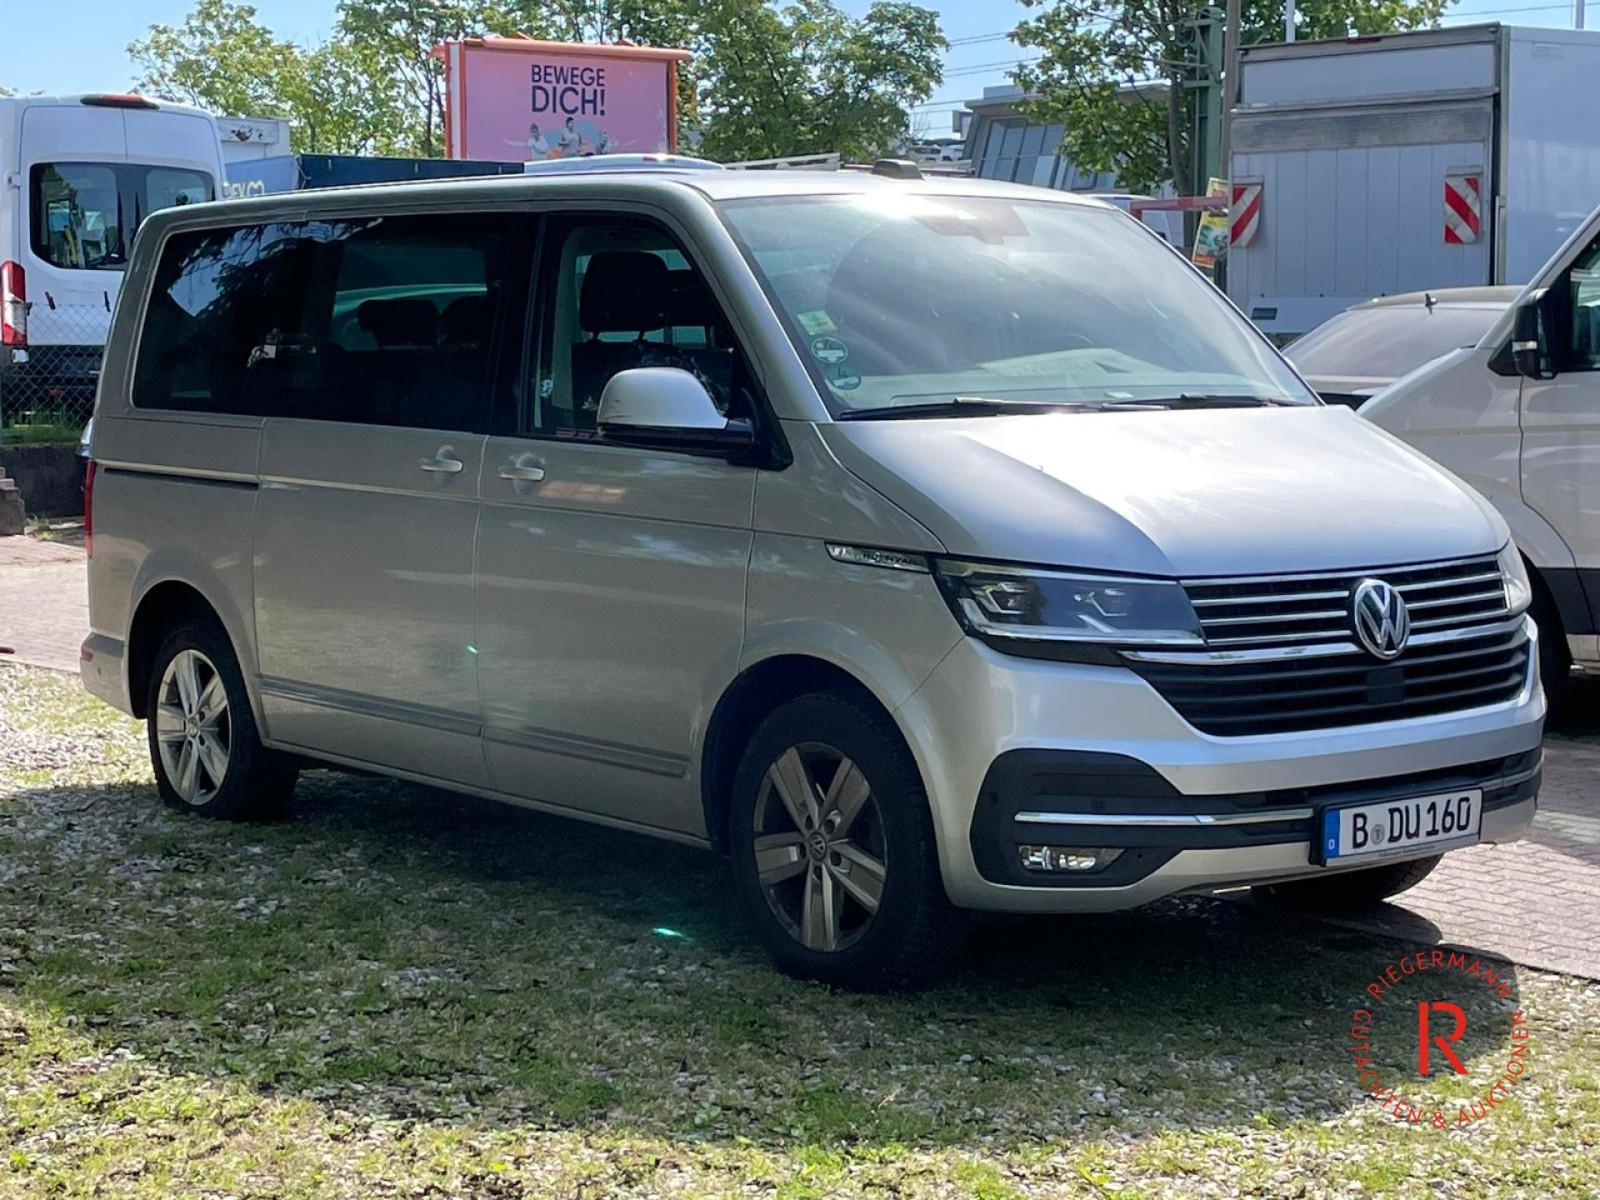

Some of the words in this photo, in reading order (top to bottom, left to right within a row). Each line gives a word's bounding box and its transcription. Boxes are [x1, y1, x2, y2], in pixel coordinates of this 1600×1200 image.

[531, 64, 606, 87] BEWEGE
[531, 85, 606, 116] DICH!
[1352, 812, 1369, 849] B
